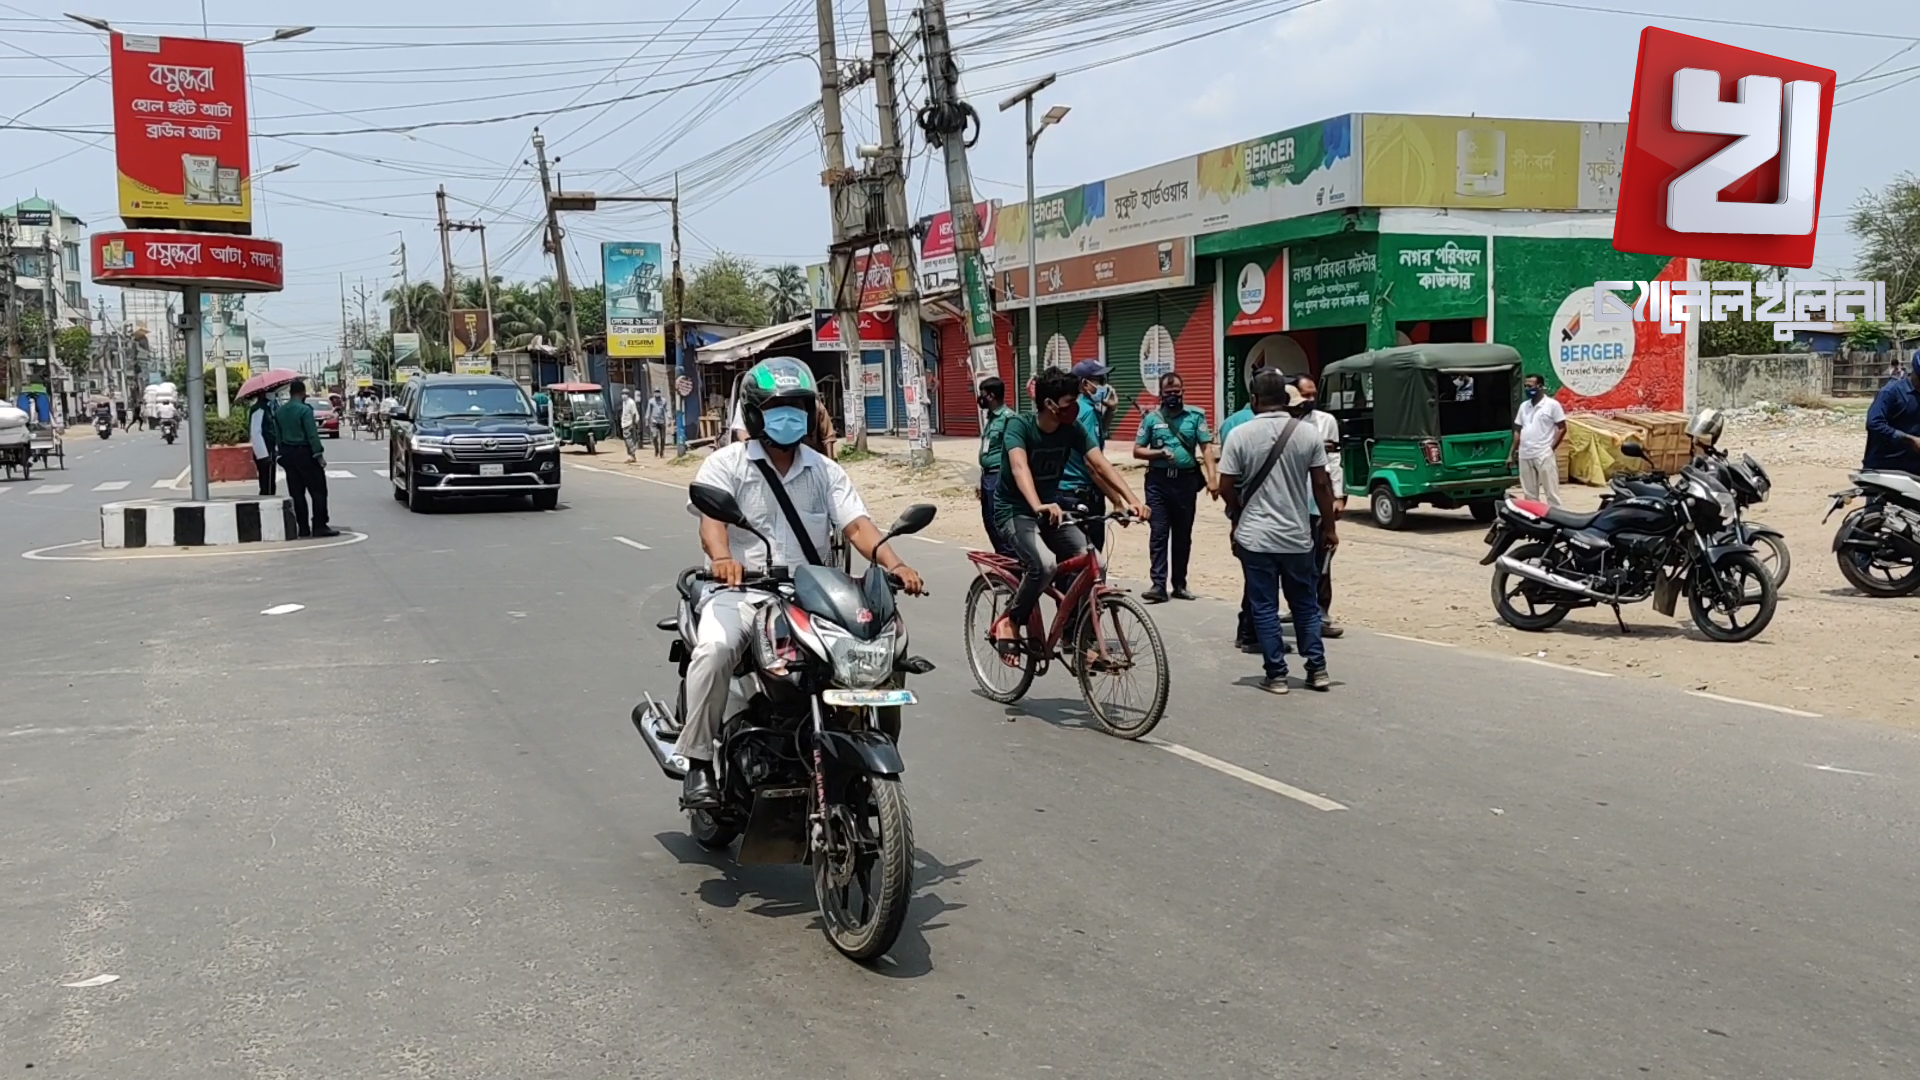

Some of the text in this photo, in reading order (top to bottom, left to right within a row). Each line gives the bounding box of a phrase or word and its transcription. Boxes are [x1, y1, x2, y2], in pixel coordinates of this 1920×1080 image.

[148, 63, 215, 95] বসুন্ধরা
[132, 98, 233, 118] হোল হুইট আটা
[145, 122, 222, 141] ব্রাউন আটা
[1244, 137, 1295, 170] BERGER
[1586, 156, 1616, 185] মুকুট
[1034, 198, 1065, 224] ERGER
[1114, 179, 1189, 220] মুকুট হার্ডওয়ার
[145, 242, 202, 270] বসুন্ধরা
[209, 246, 248, 268] আটা,
[1293, 250, 1377, 284] নগর পরিবহন কাউন্টার
[1399, 240, 1482, 267] নগর পরিবহন
[1416, 266, 1475, 291] কাউন্টার
[1560, 342, 1623, 362] BERGER
[1227, 356, 1236, 389] PAINTS
[1561, 367, 1591, 376] Trusted
